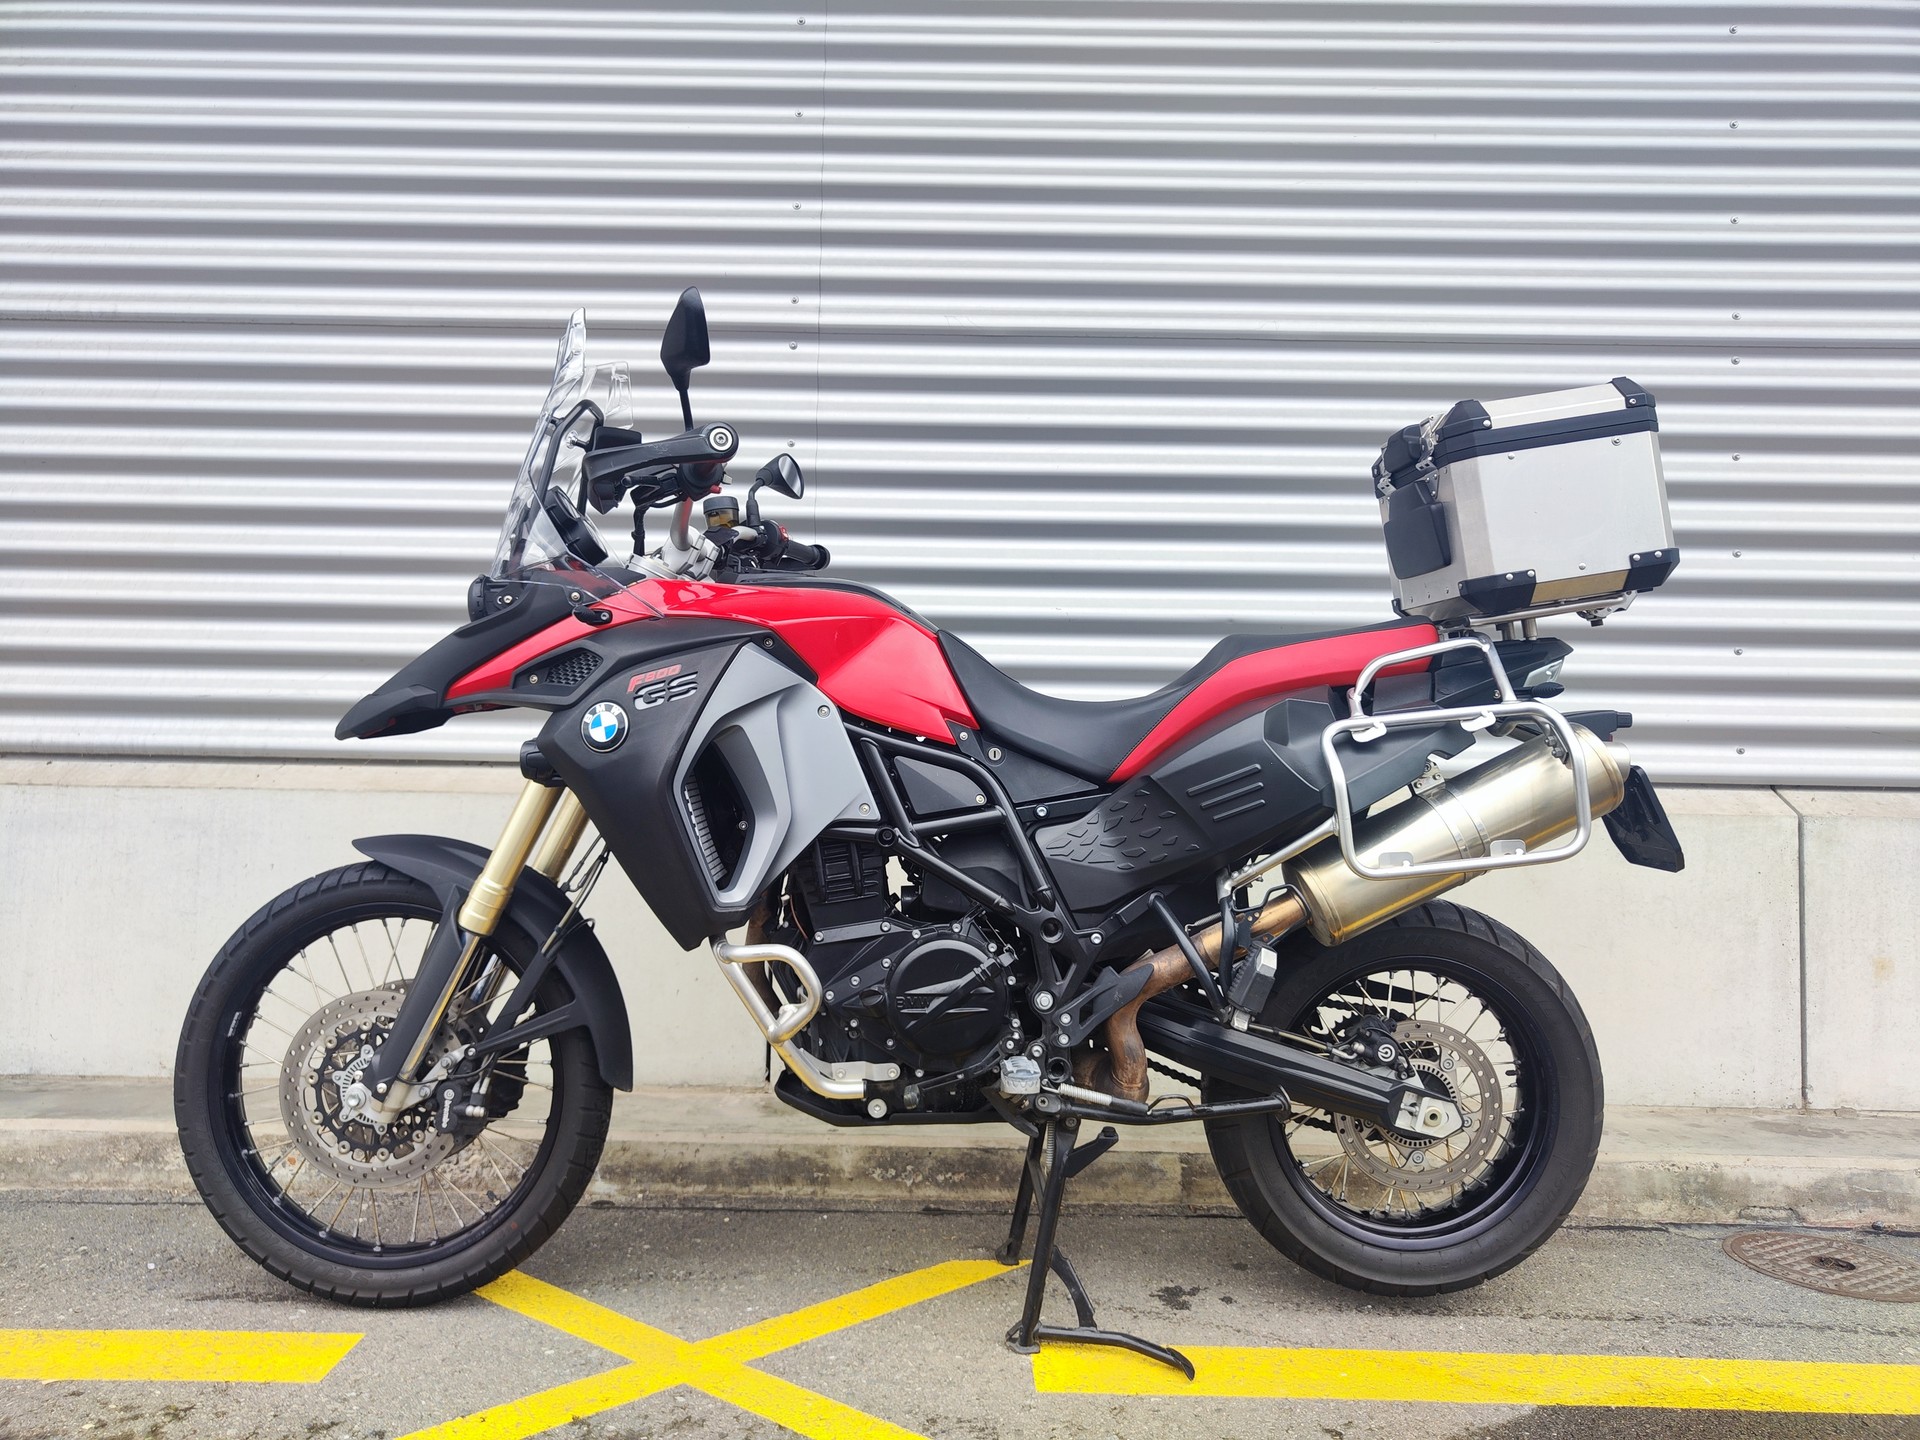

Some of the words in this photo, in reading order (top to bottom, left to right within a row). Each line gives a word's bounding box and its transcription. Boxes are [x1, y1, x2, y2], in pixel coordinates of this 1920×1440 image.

[626, 664, 682, 694] F800
[633, 671, 698, 710] GS
[583, 703, 622, 724] BMW
[895, 996, 932, 1008] BMW
